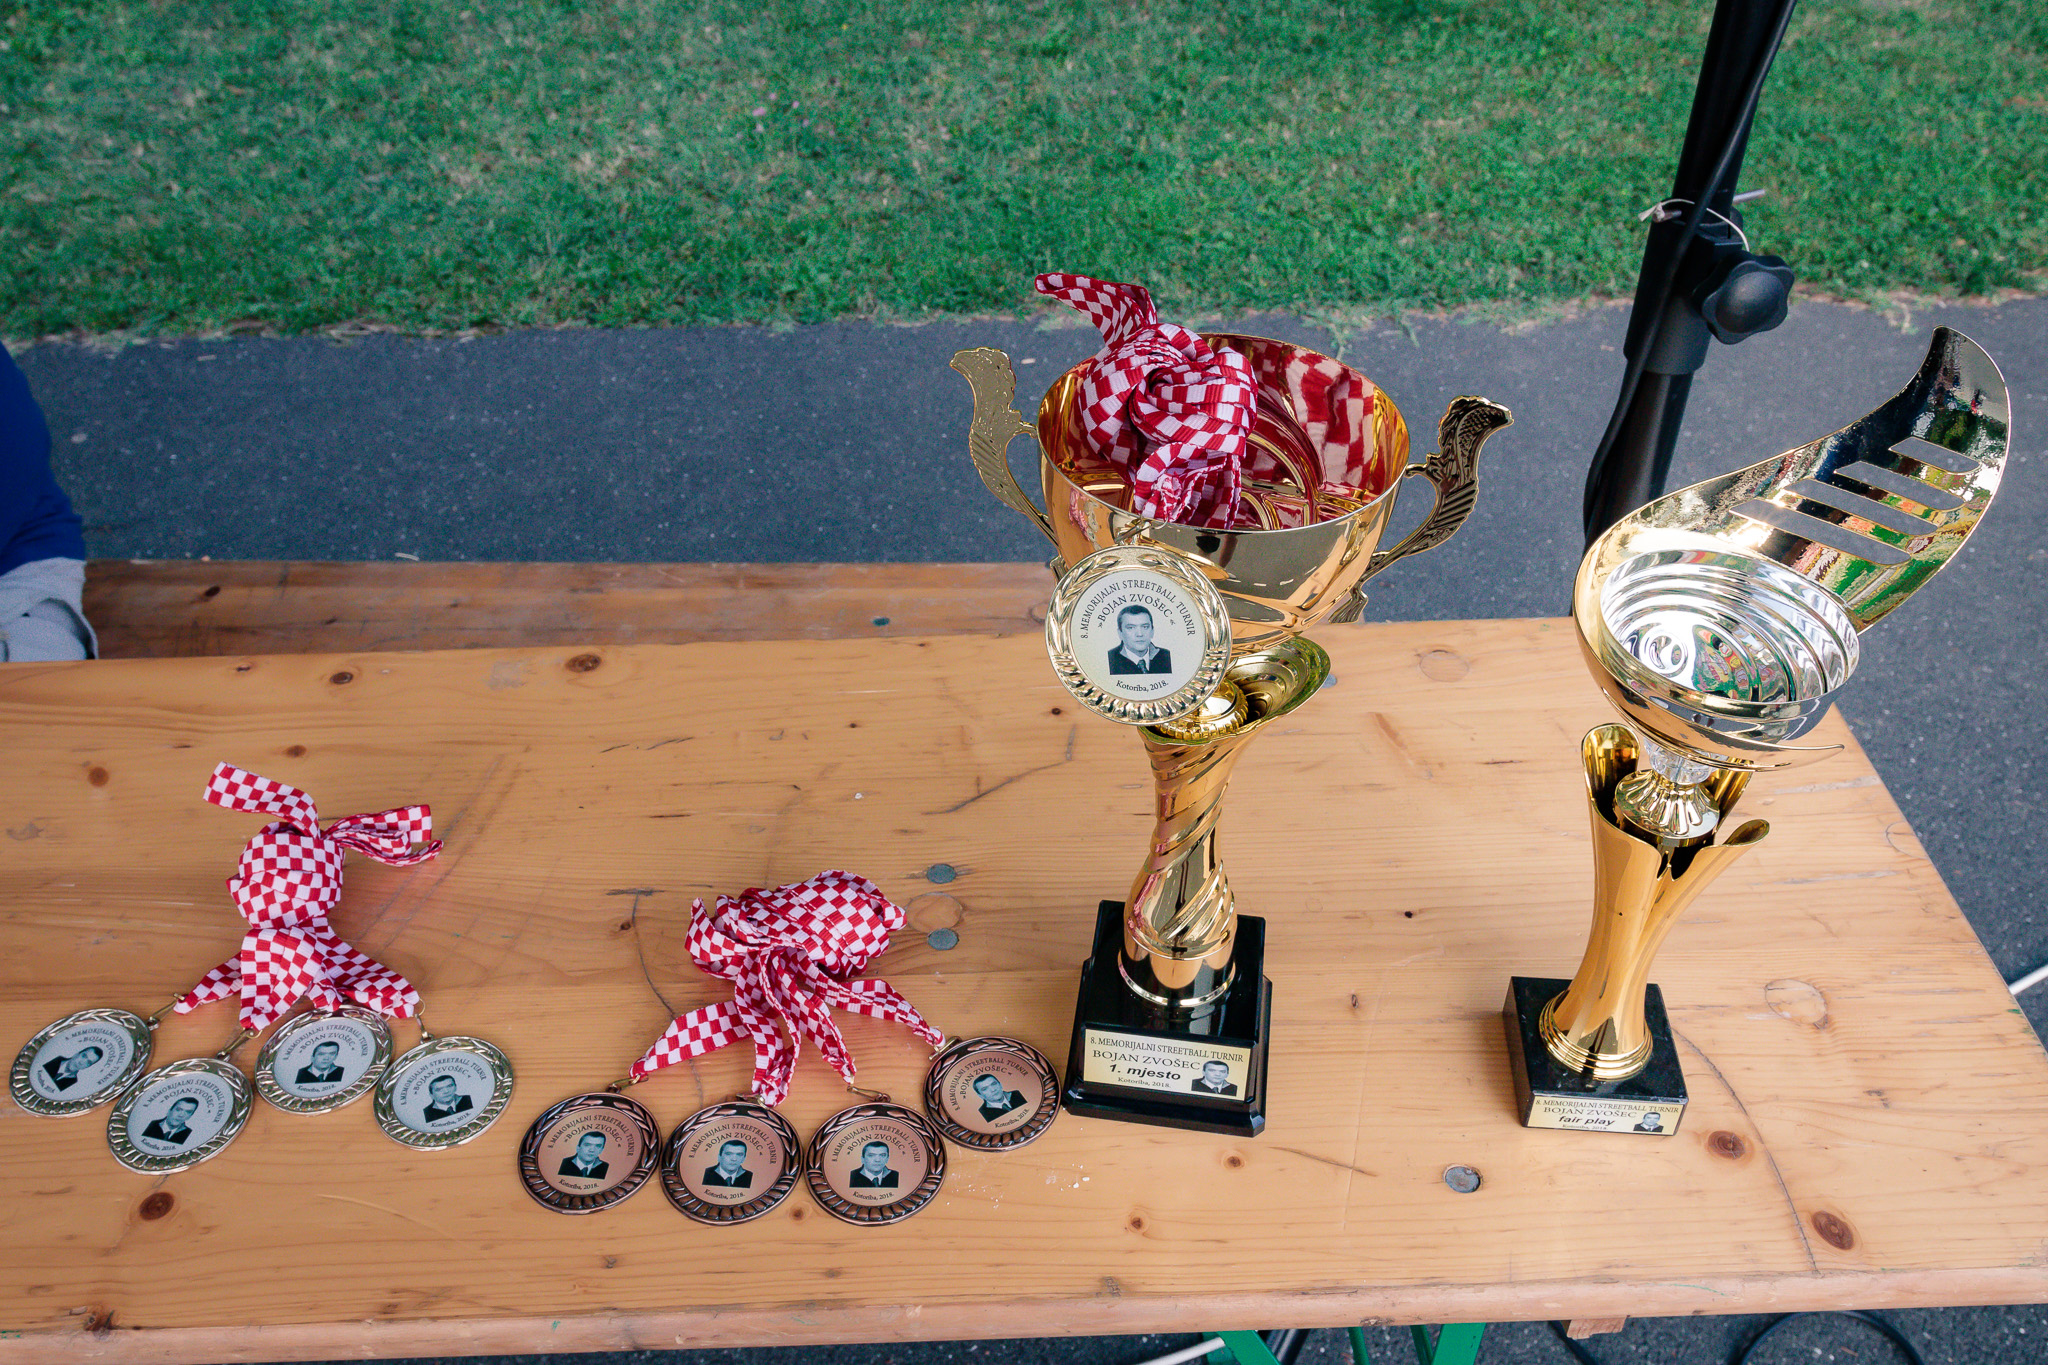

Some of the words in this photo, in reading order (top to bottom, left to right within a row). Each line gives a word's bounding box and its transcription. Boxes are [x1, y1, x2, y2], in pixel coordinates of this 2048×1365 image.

[1123, 579, 1176, 603] STREETBALL
[1080, 582, 1121, 631] MEMORIJALNI
[1178, 602, 1196, 636] TURNIR
[1081, 631, 1088, 639] 8.
[1116, 679, 1149, 692] Kotoriba,
[1150, 680, 1169, 691] 2018.
[1090, 1037, 1097, 1045] 8.
[1098, 1038, 1156, 1053] MEMORIJALNI
[1157, 1045, 1209, 1059] STREETBALL
[1210, 1051, 1243, 1062] TURNIR
[965, 1058, 1005, 1071] STREETBALL
[1007, 1060, 1029, 1077] TURNIR
[1092, 1050, 1139, 1063] BOJAN
[1142, 1055, 1200, 1070] ZVOŠEC
[1109, 1064, 1121, 1073] 1.
[1126, 1066, 1181, 1081] mjesto
[1117, 1076, 1151, 1087] Kotoriba,
[1151, 1081, 1170, 1089] 2018.
[1542, 1100, 1598, 1109] MEMORIJALNI
[1598, 1103, 1646, 1112] STREETBALL
[1544, 1107, 1584, 1115] BOJAN
[1586, 1109, 1638, 1118] ZVOŠEC
[1558, 1116, 1583, 1124] fair
[1584, 1117, 1616, 1126] play
[550, 1115, 592, 1144] MEMORIJALNI
[593, 1115, 630, 1134] STREETBALL
[625, 1133, 635, 1157] TURNIR
[691, 1123, 730, 1153] MEMORIJALNI
[731, 1123, 769, 1141] STREETBALL
[766, 1140, 777, 1165] TURNIR
[832, 1125, 869, 1158] MEMORIJALNI
[870, 1124, 909, 1142] STREETBALL
[908, 1140, 921, 1163] TURNIR
